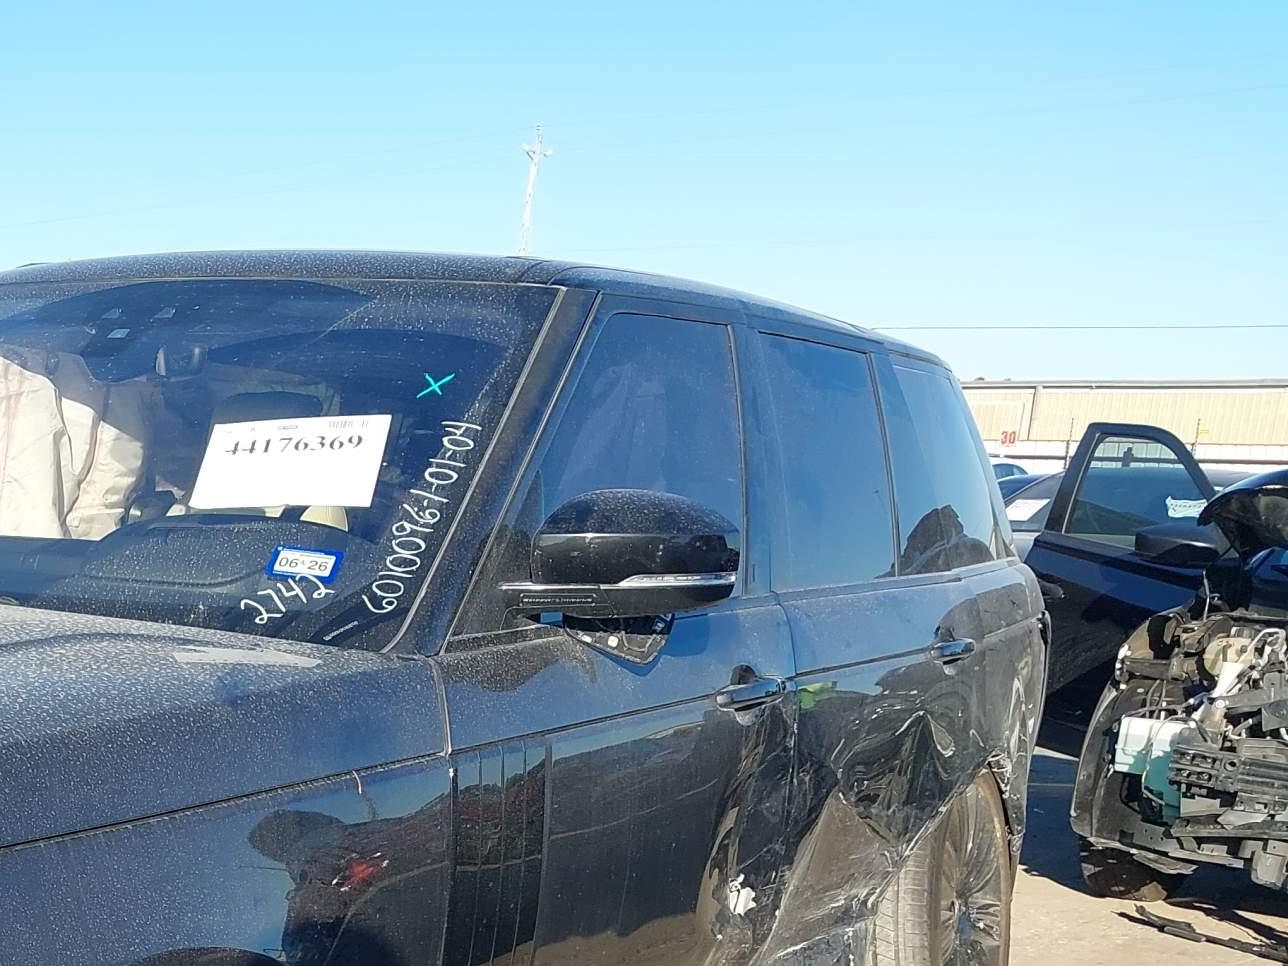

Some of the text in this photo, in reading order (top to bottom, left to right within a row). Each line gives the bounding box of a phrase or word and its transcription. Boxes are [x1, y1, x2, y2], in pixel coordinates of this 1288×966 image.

[225, 434, 364, 456] 44176369
[1000, 430, 1016, 444] 30
[278, 556, 329, 572] 06 26
[240, 573, 336, 625] 2742
